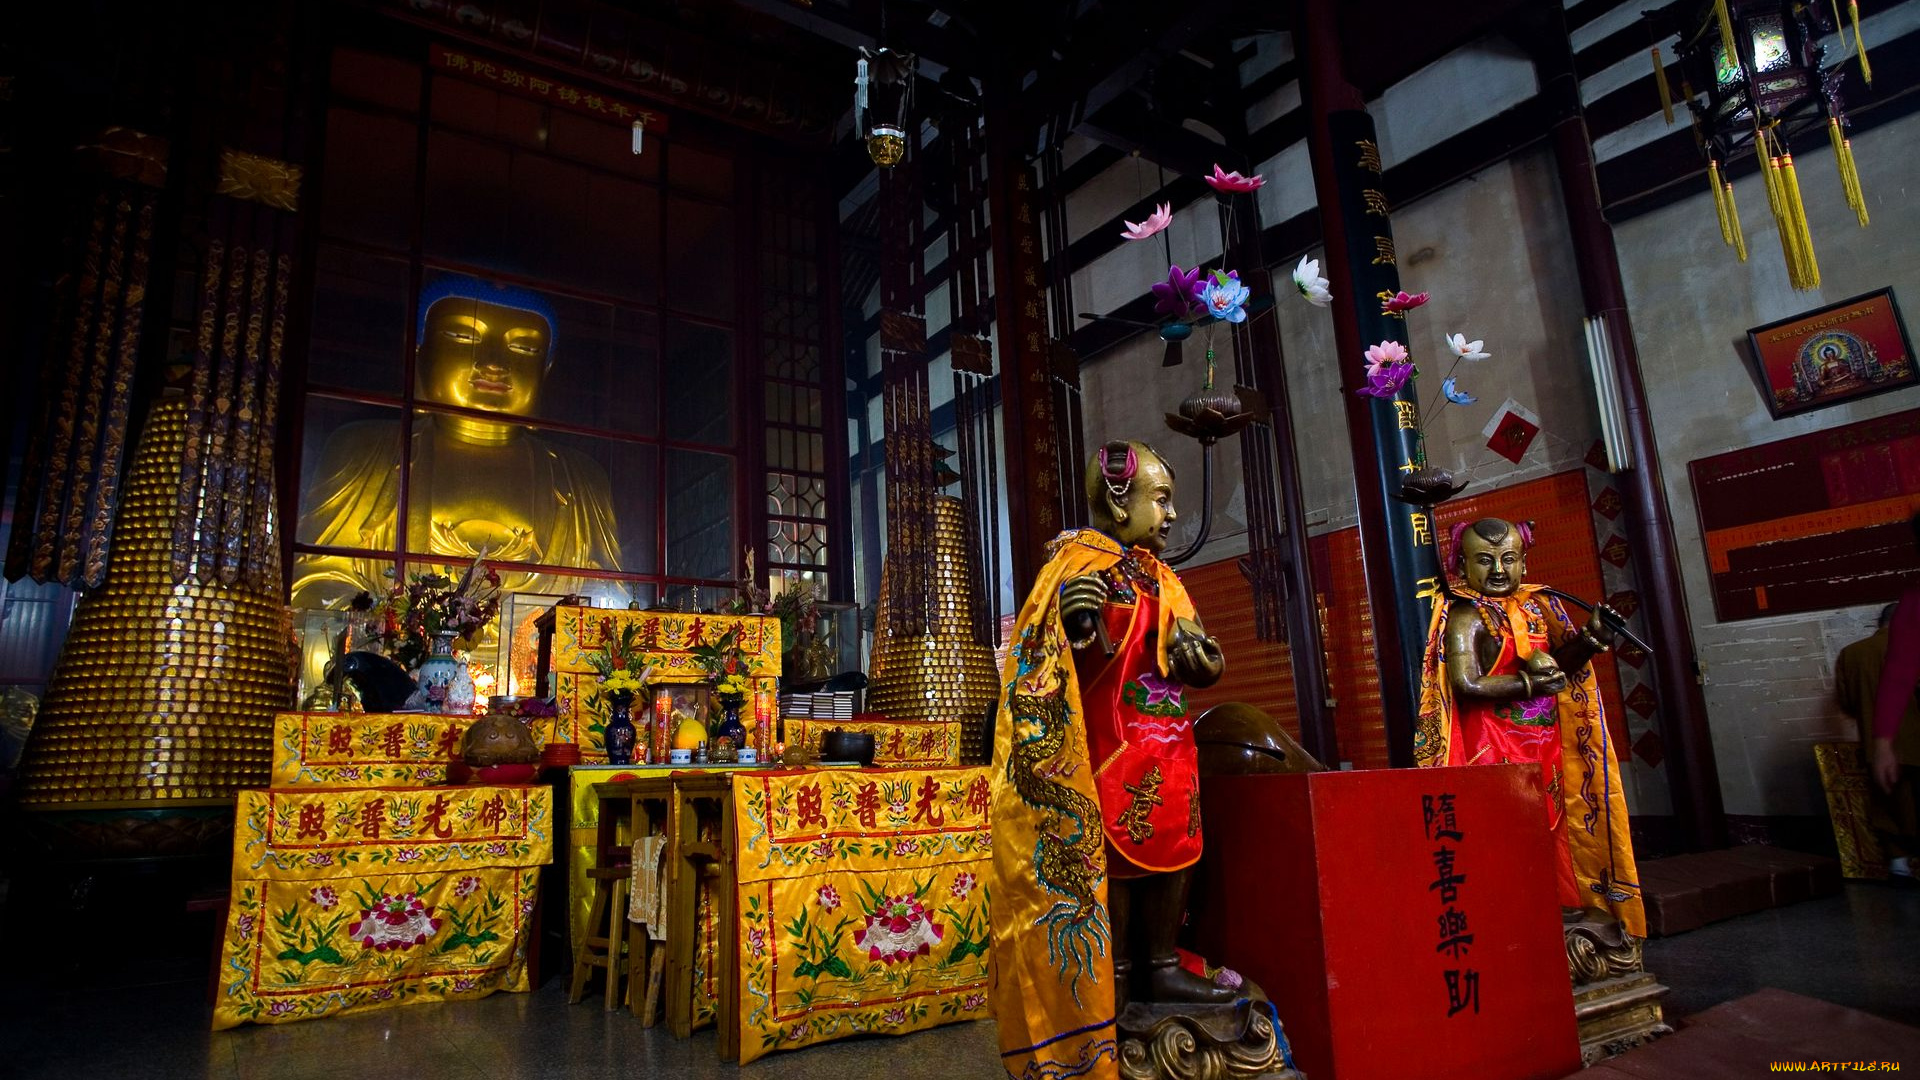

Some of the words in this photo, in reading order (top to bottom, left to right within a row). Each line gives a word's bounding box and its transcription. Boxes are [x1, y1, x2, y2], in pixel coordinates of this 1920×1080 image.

[296, 794, 507, 842] 佛光普照
[796, 775, 991, 829] 佛光普照
[1421, 793, 1480, 1018] 隨喜樂助
